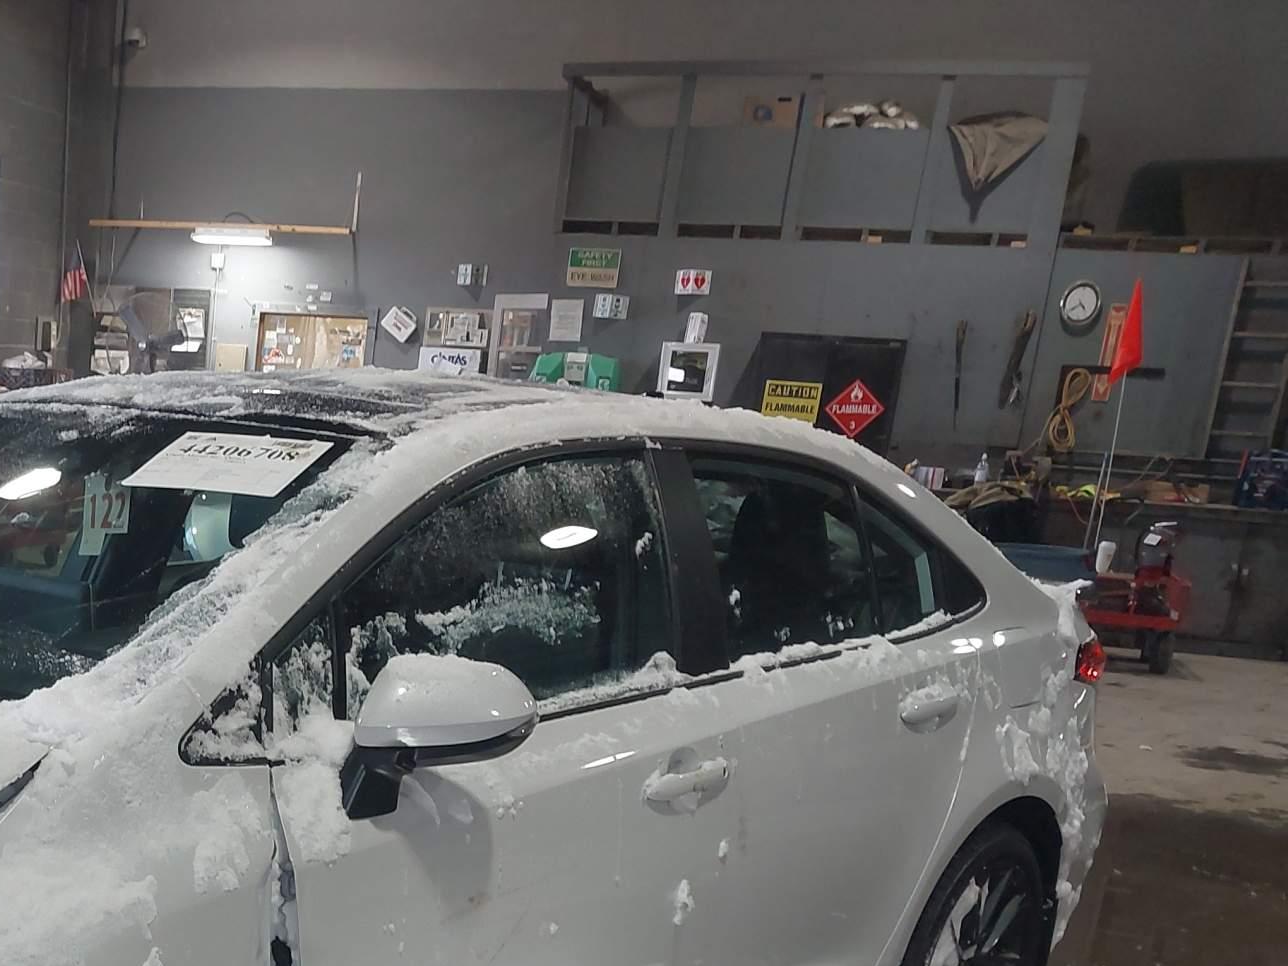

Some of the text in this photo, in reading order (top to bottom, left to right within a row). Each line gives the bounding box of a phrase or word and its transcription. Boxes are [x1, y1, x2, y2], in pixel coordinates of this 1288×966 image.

[577, 251, 613, 259] SAFETY
[581, 259, 607, 267] FIRST
[570, 271, 615, 281] EYE WASH
[769, 384, 817, 399] CAUTION
[765, 402, 815, 414] FLAMMABLE
[832, 404, 877, 414] FLAMMABLE
[849, 420, 856, 430] 3
[178, 443, 300, 462] 44206708
[90, 491, 126, 529] 122
